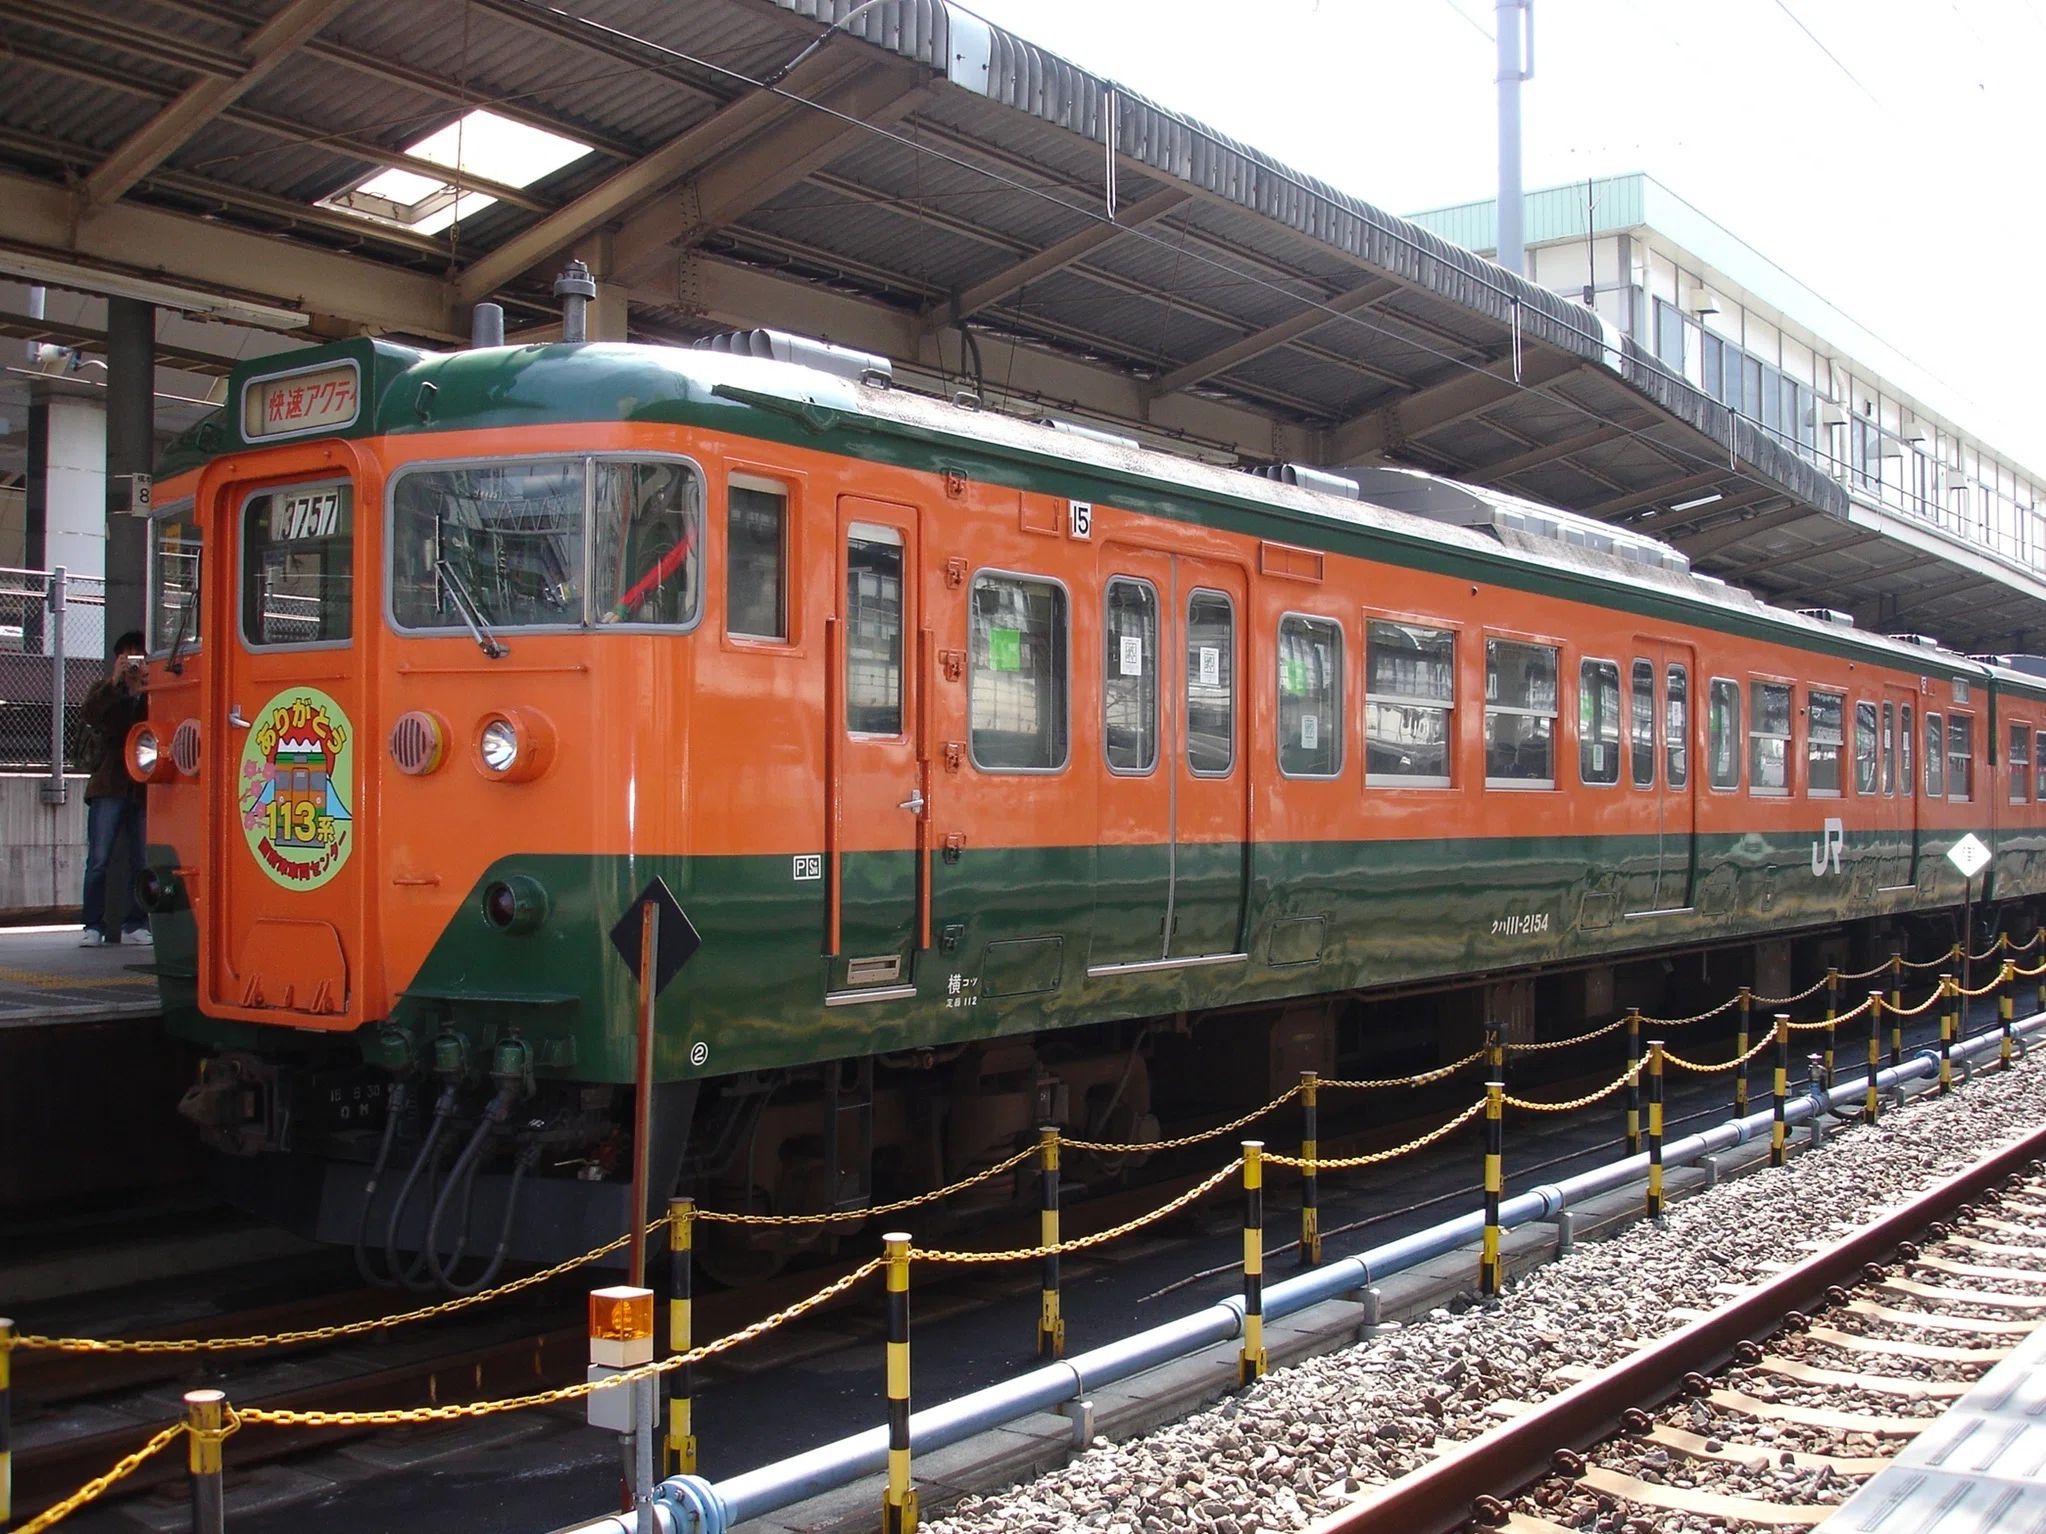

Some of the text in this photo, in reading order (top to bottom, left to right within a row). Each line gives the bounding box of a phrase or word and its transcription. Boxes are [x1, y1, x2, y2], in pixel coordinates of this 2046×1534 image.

[140, 488, 149, 503] 8
[282, 495, 338, 540] 3757
[1073, 505, 1089, 534] 15
[255, 698, 346, 756] ありがとう
[265, 800, 335, 842] 113系
[1812, 818, 1843, 877] JR
[947, 973, 978, 995] 横コツ
[963, 995, 977, 1006] 112
